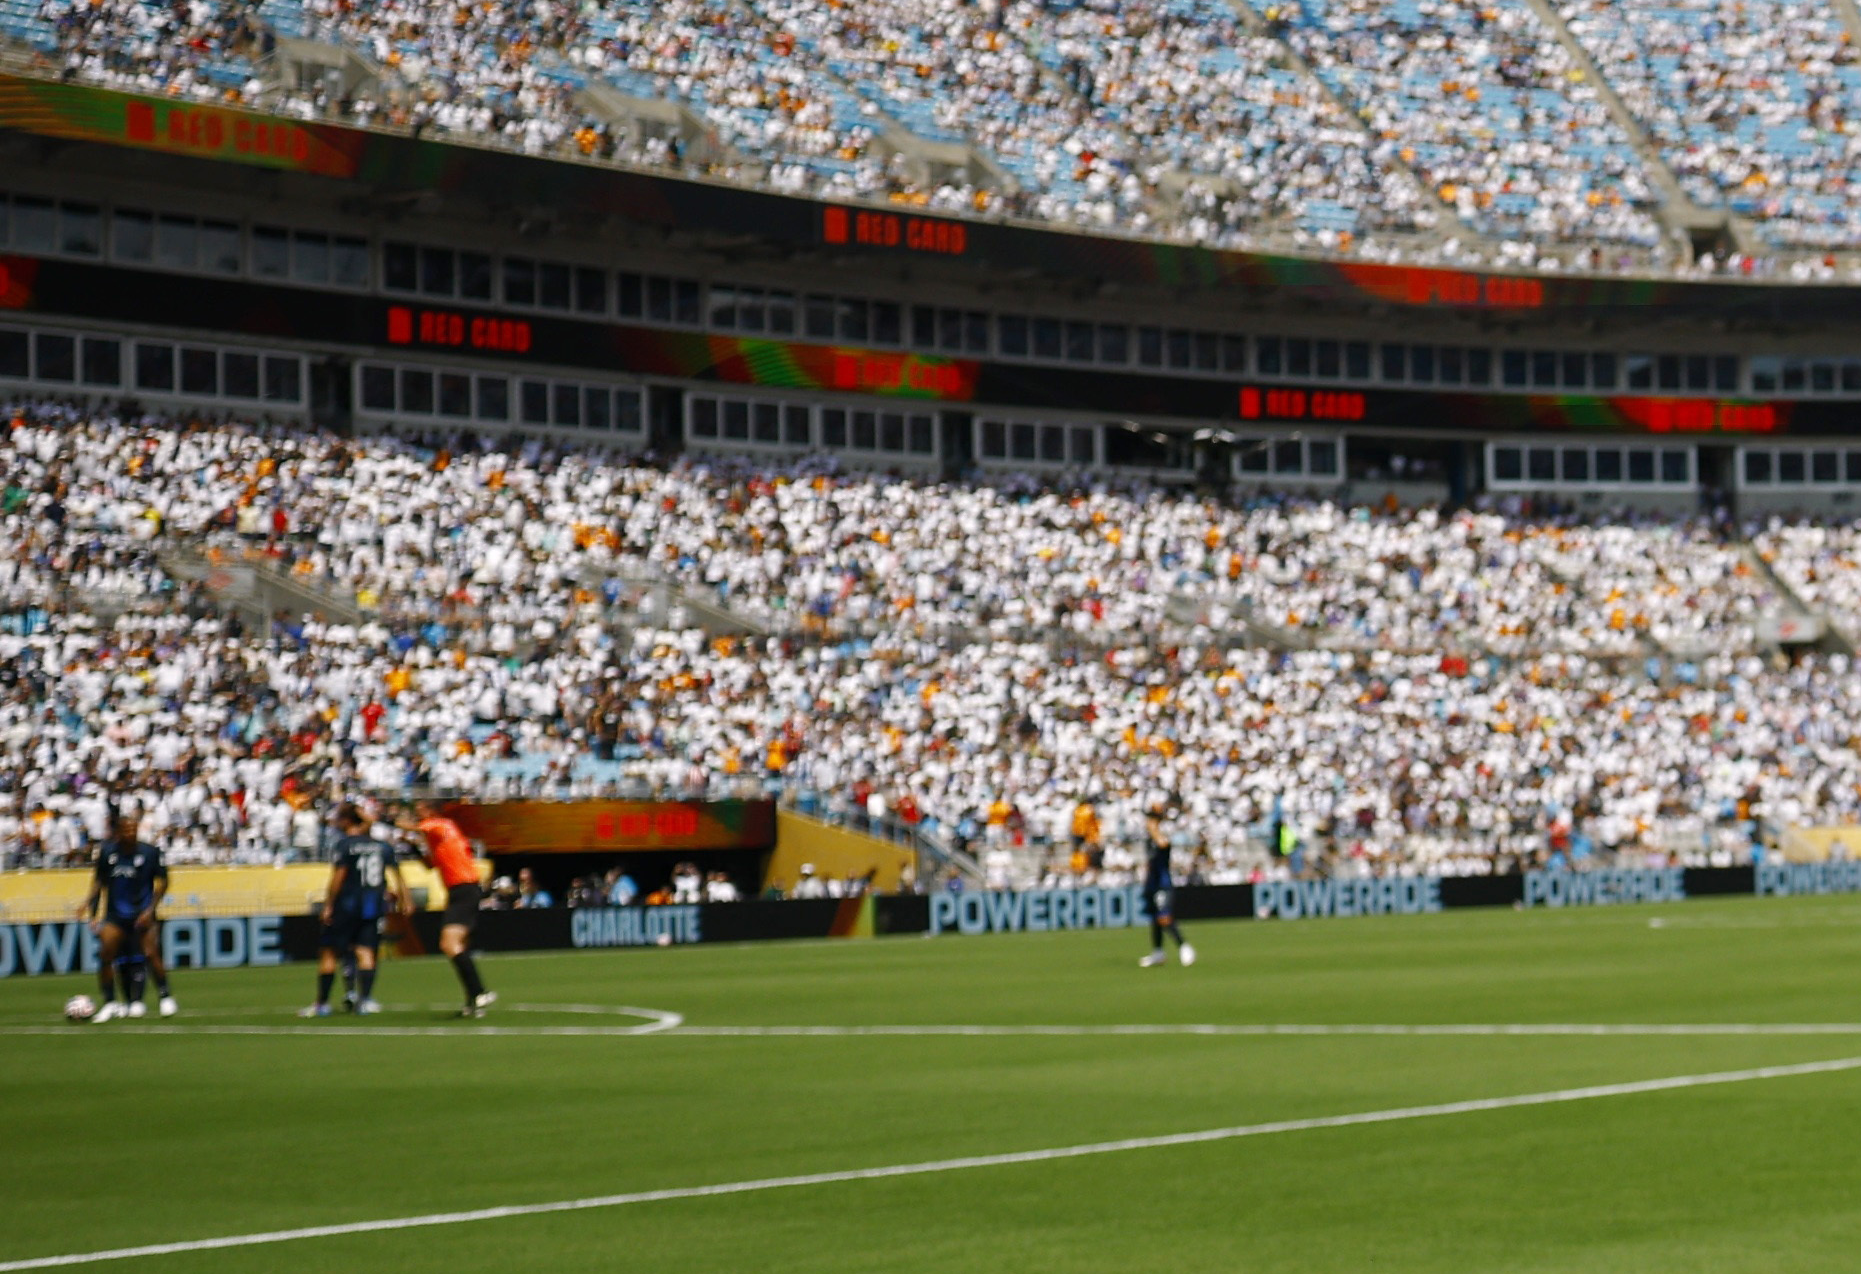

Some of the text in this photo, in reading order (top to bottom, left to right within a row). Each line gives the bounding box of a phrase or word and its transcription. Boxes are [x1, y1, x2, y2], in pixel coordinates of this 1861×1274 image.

[1253, 876, 1442, 921] POWERADE
[1524, 867, 1685, 908] POWERADE
[571, 906, 700, 948] CHARLOTTE
